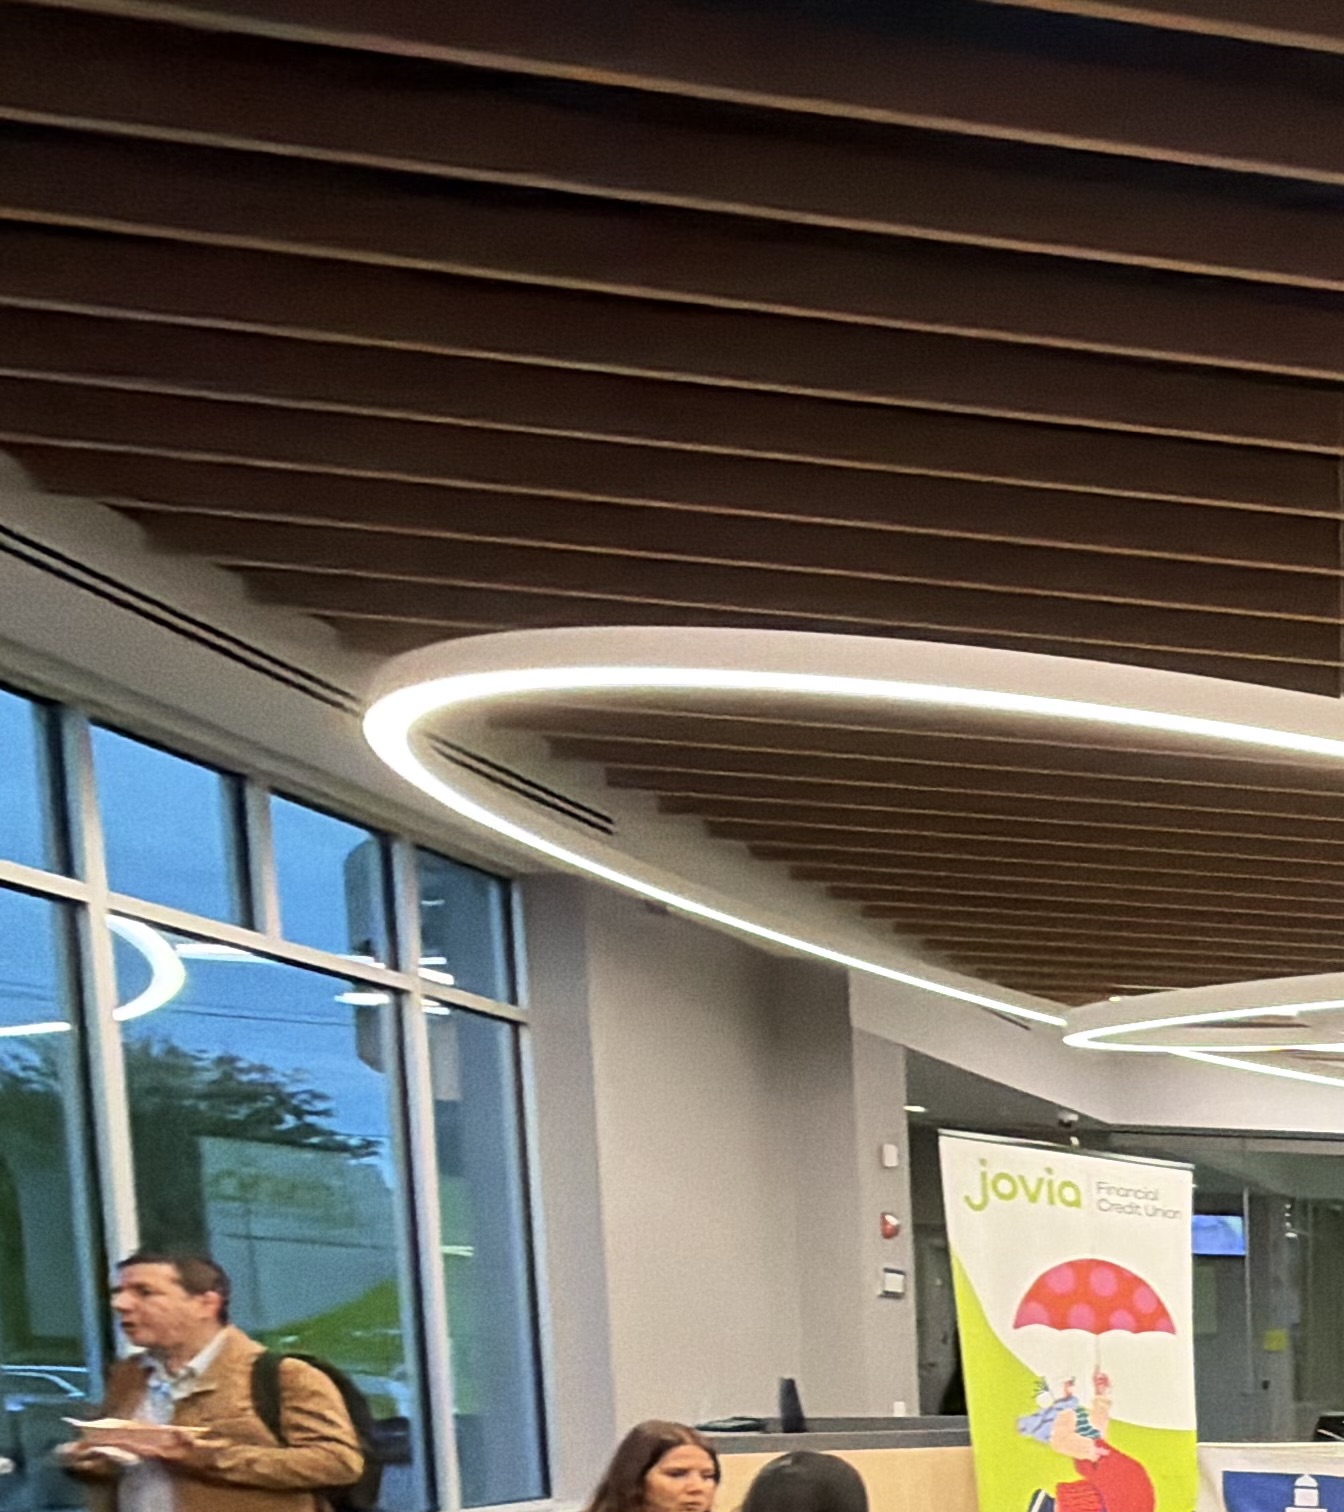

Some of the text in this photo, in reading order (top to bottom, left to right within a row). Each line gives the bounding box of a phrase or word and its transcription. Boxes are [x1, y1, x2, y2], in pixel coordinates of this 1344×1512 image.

[964, 1158, 1081, 1212] jovia
[1096, 1181, 1159, 1201] Financial
[1097, 1198, 1182, 1219] Credit Union
